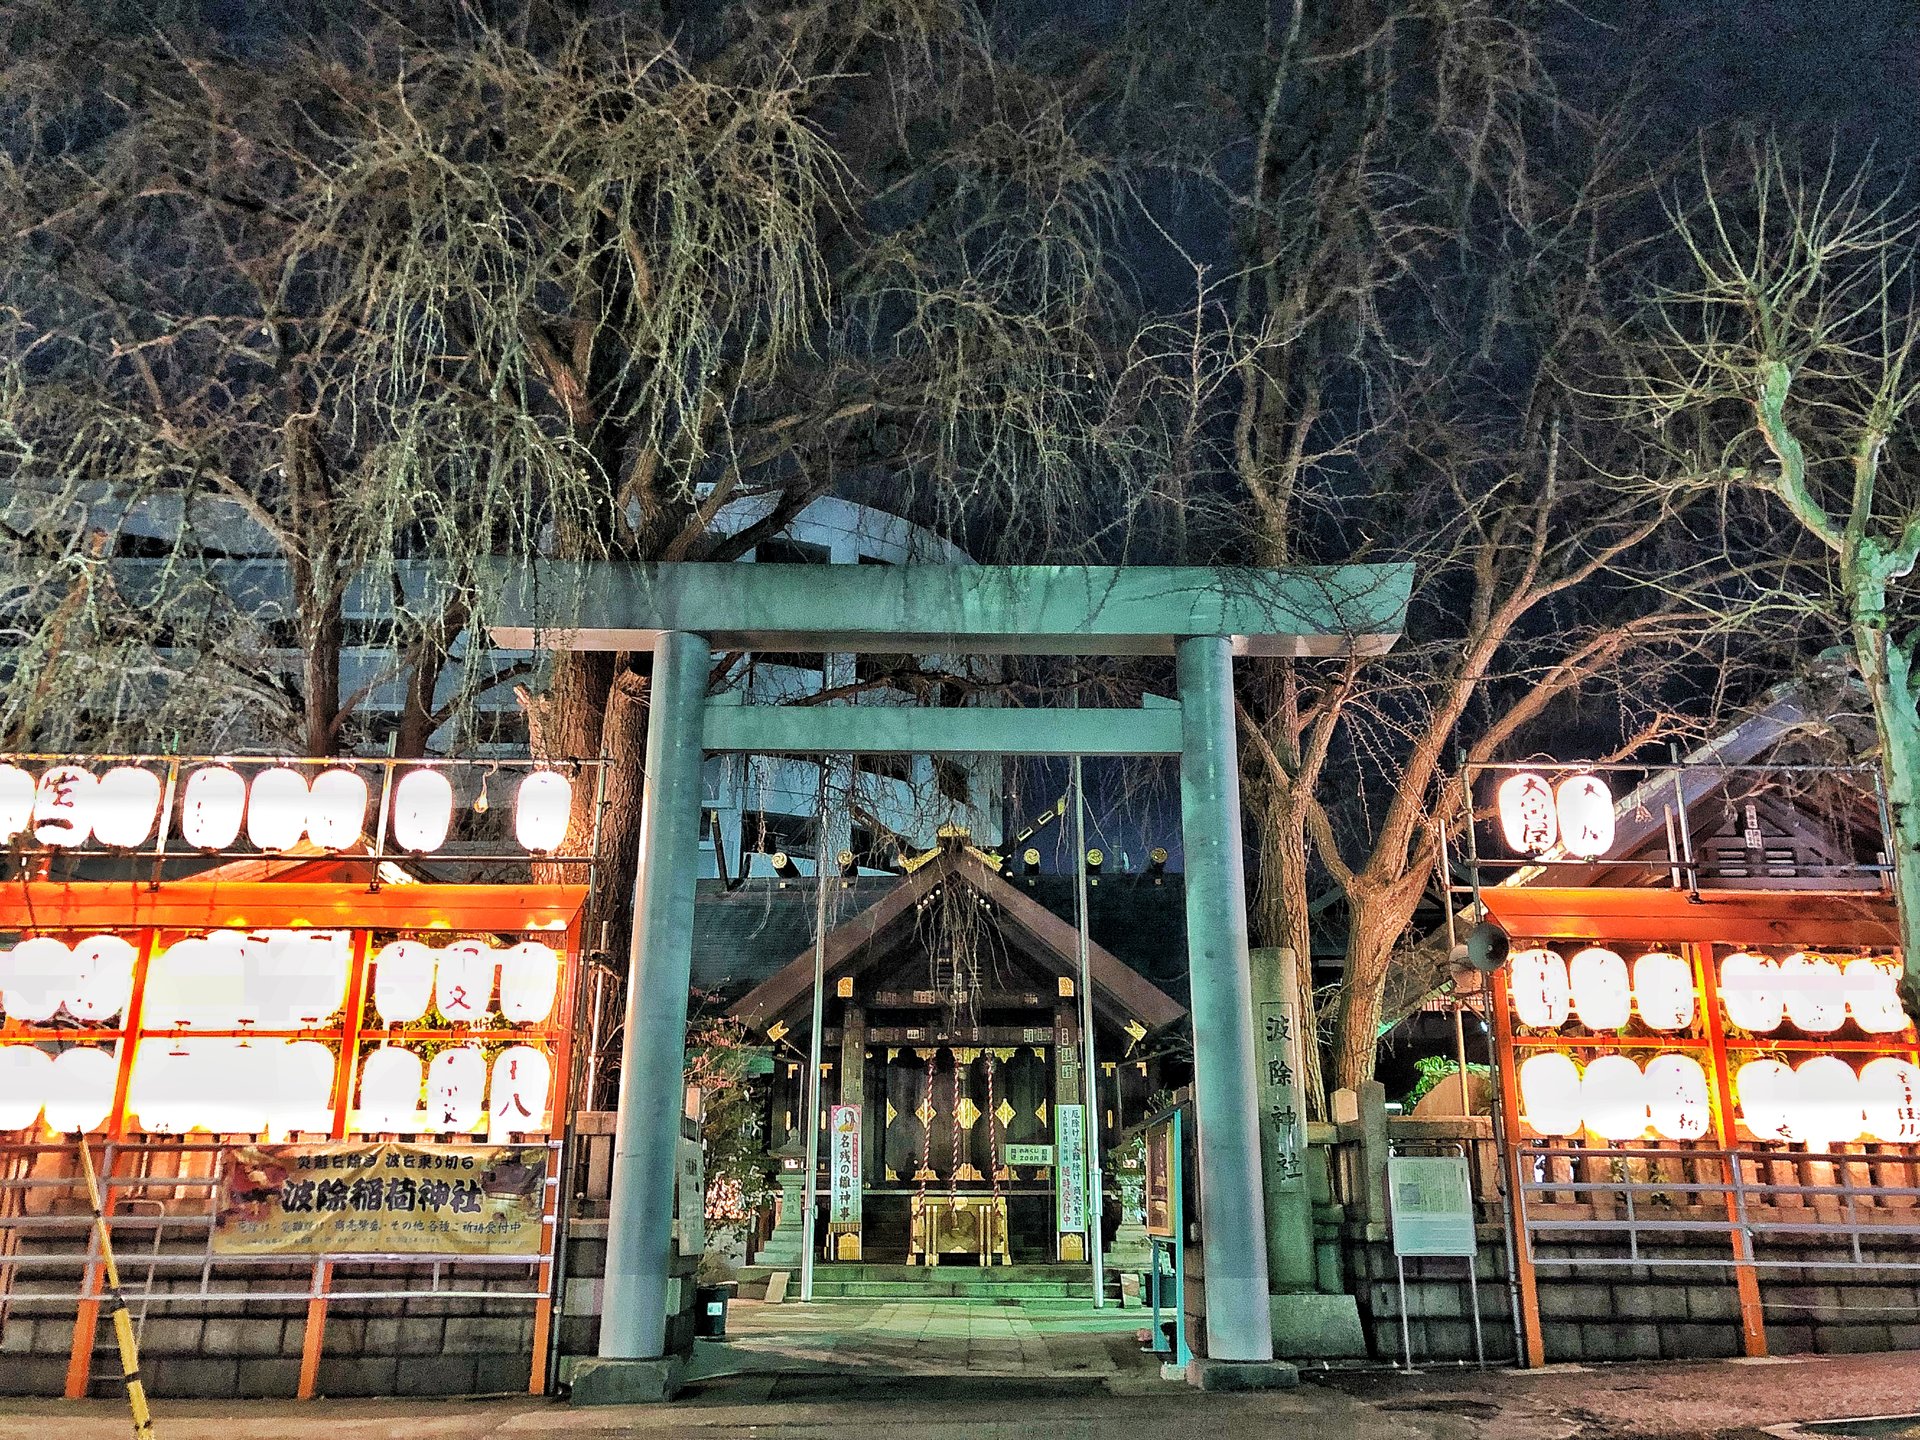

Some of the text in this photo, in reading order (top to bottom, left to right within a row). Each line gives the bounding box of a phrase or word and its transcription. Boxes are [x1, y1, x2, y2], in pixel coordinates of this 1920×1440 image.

[1266, 1014, 1302, 1181] 波除神社
[385, 1152, 474, 1170] 波を乗り切る
[281, 1176, 483, 1213] 波除稲荷神社
